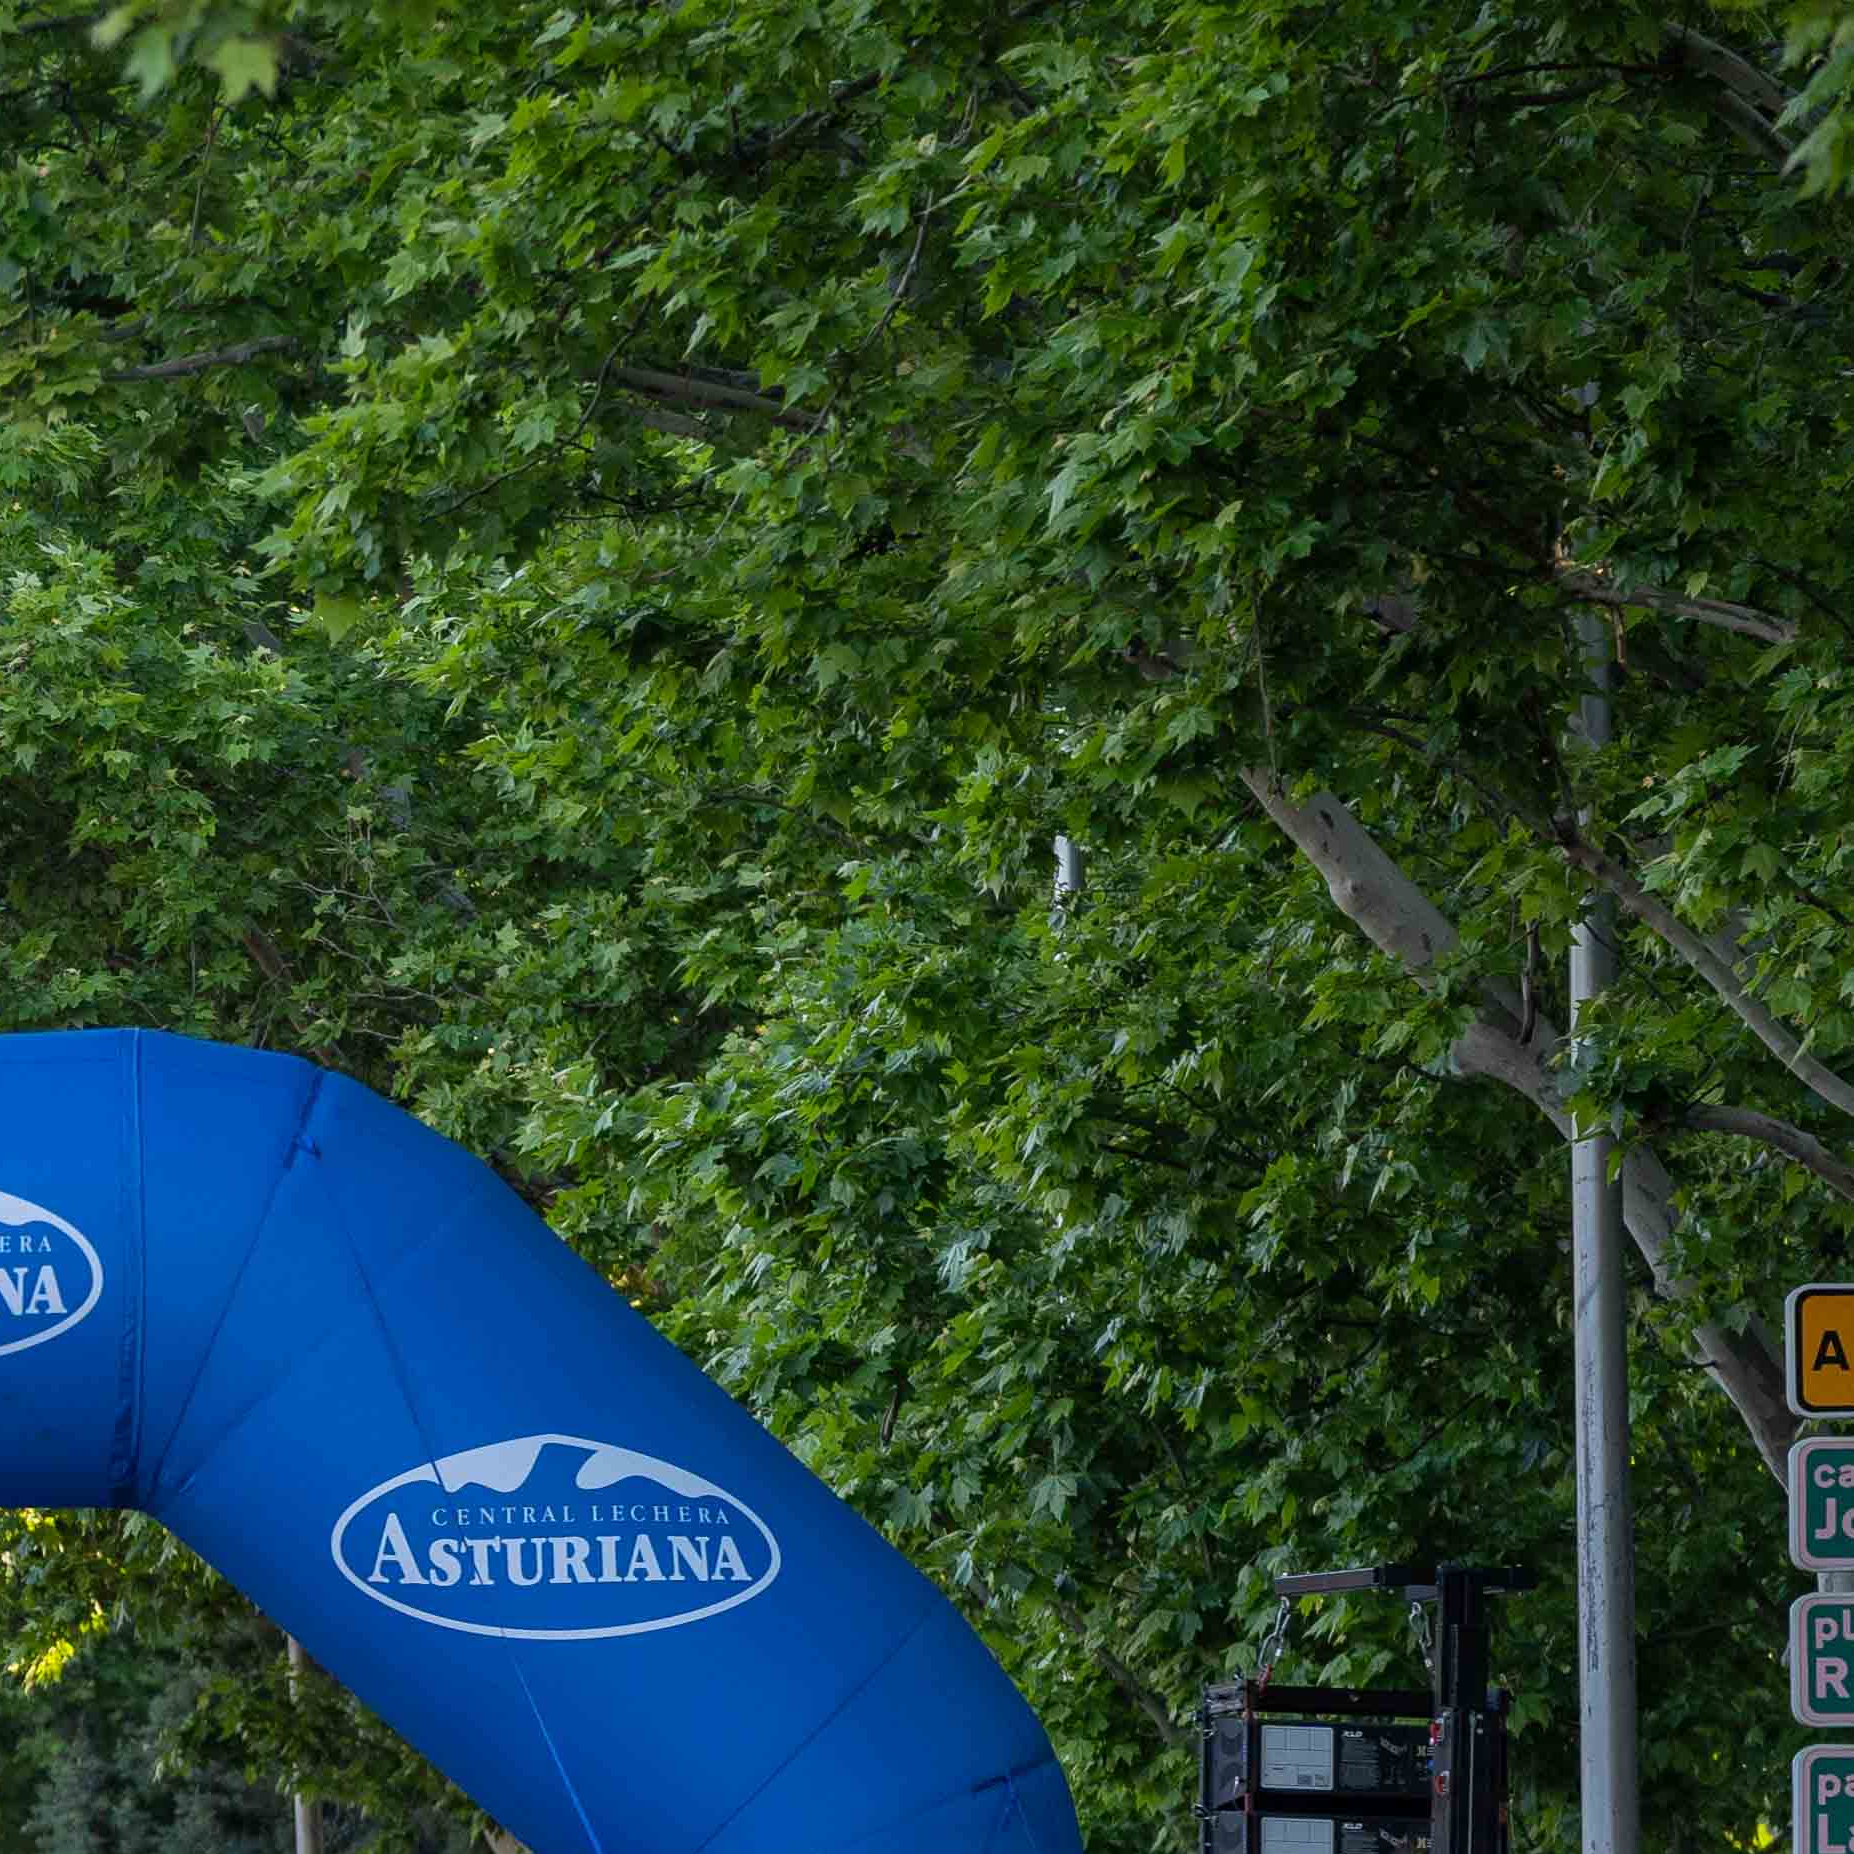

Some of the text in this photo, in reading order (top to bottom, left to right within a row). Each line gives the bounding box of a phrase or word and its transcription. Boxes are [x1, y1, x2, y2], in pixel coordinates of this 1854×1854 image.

[431, 1504, 731, 1527] CENTRAL LECHERA
[368, 1512, 753, 1586] ASTURIANA
